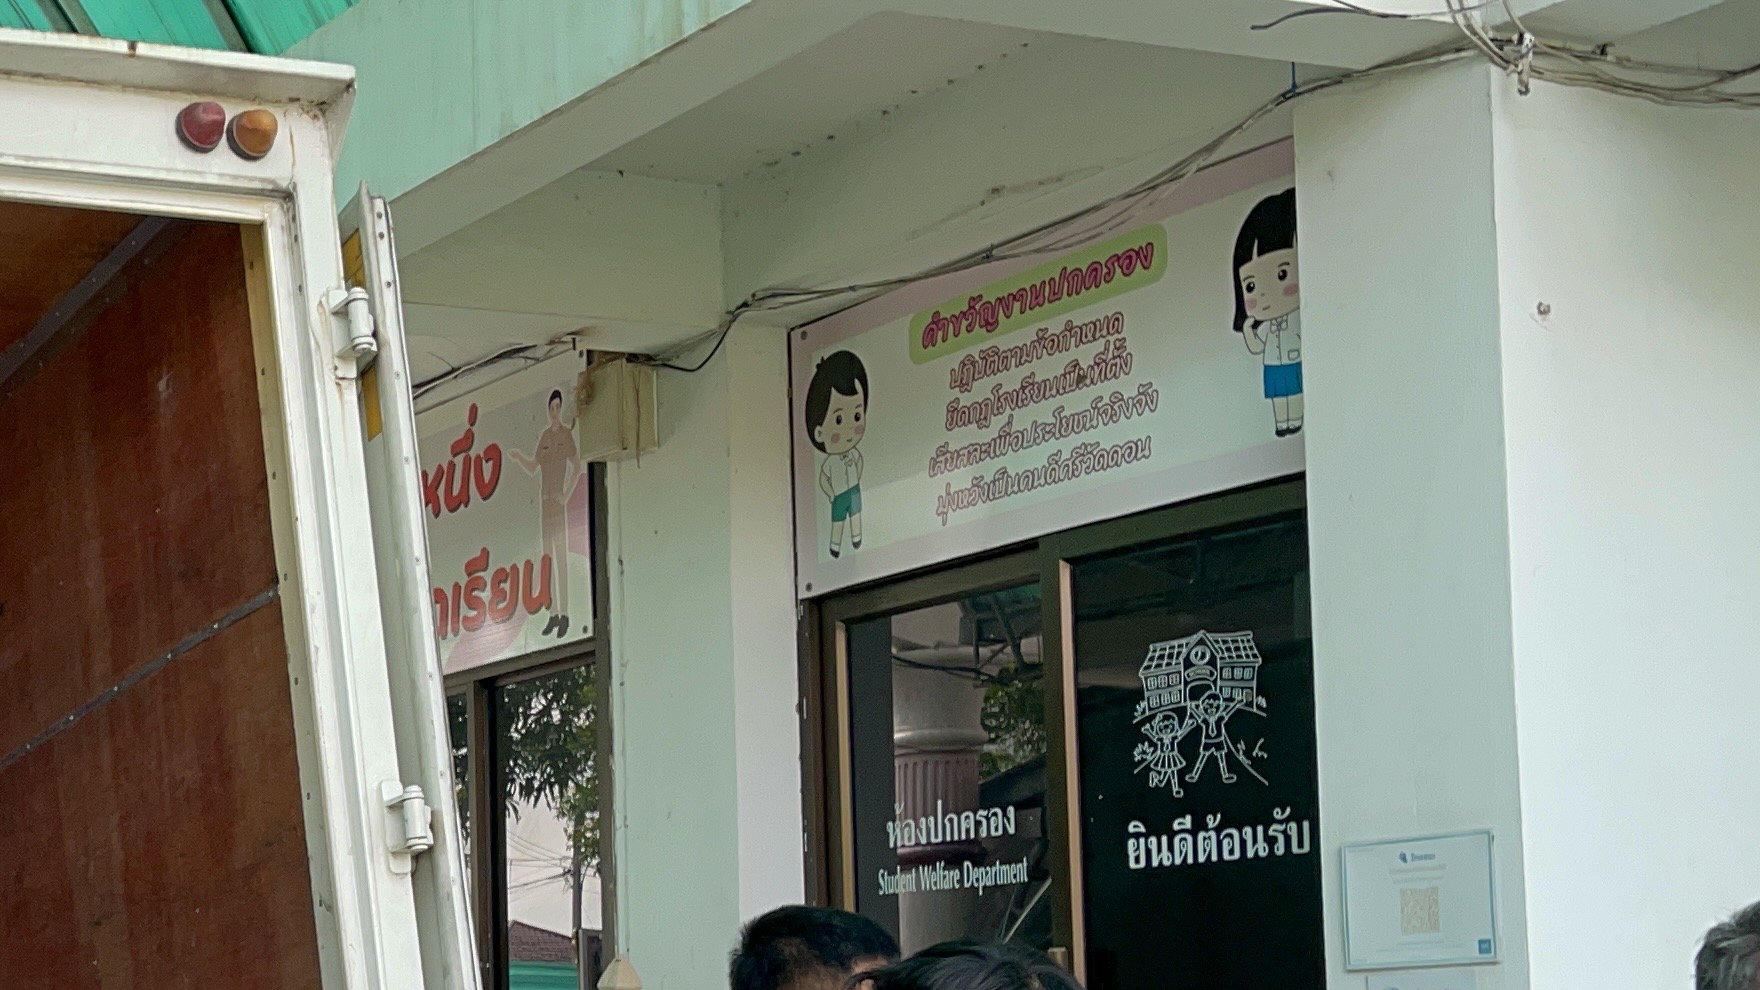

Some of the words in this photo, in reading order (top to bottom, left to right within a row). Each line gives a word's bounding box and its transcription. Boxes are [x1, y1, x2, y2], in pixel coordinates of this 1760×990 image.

[922, 242, 1154, 349] คำขวัญงานปกครอง
[949, 312, 1124, 393] ปฏิบัติตามข้อกำหนด
[886, 799, 1016, 849] ห้องปกครอง
[1127, 806, 1311, 870] ยินดีต้อนรับ
[878, 865, 917, 895] Student
[919, 860, 961, 891] Welfare
[963, 856, 1029, 896] Department
